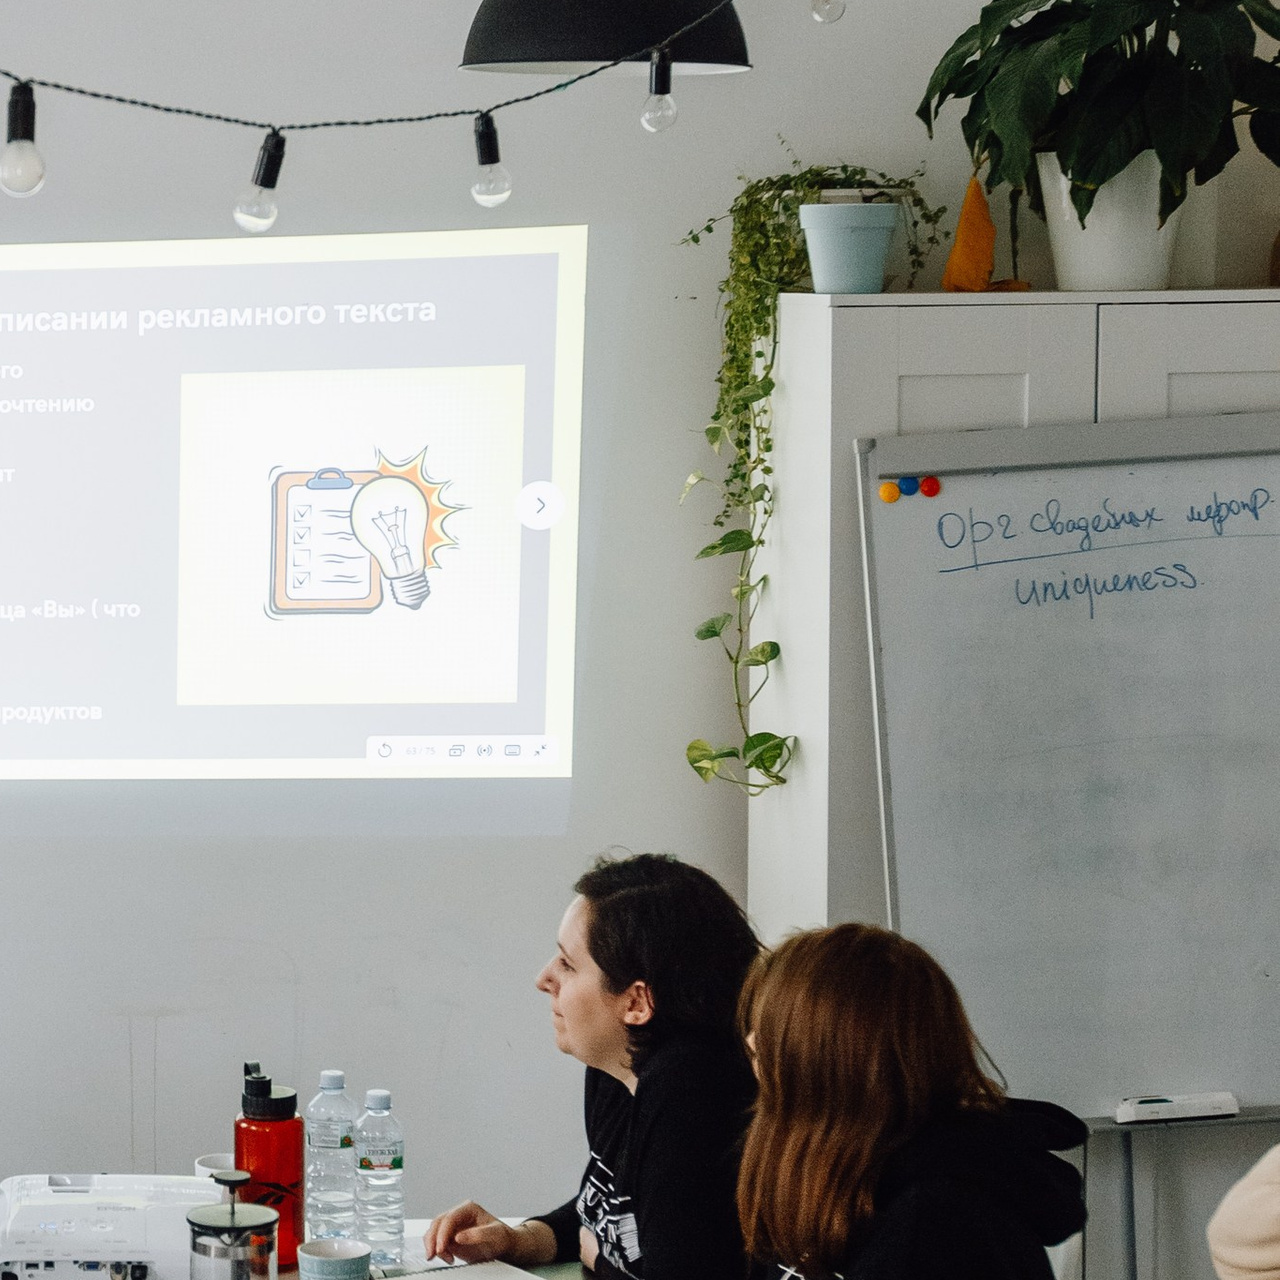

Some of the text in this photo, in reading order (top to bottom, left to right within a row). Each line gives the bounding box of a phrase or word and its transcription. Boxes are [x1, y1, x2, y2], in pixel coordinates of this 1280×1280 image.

[138, 304, 327, 337] рекламного
[333, 301, 437, 324] текста
[31, 599, 86, 619] «Вы»
[103, 603, 142, 618] что
